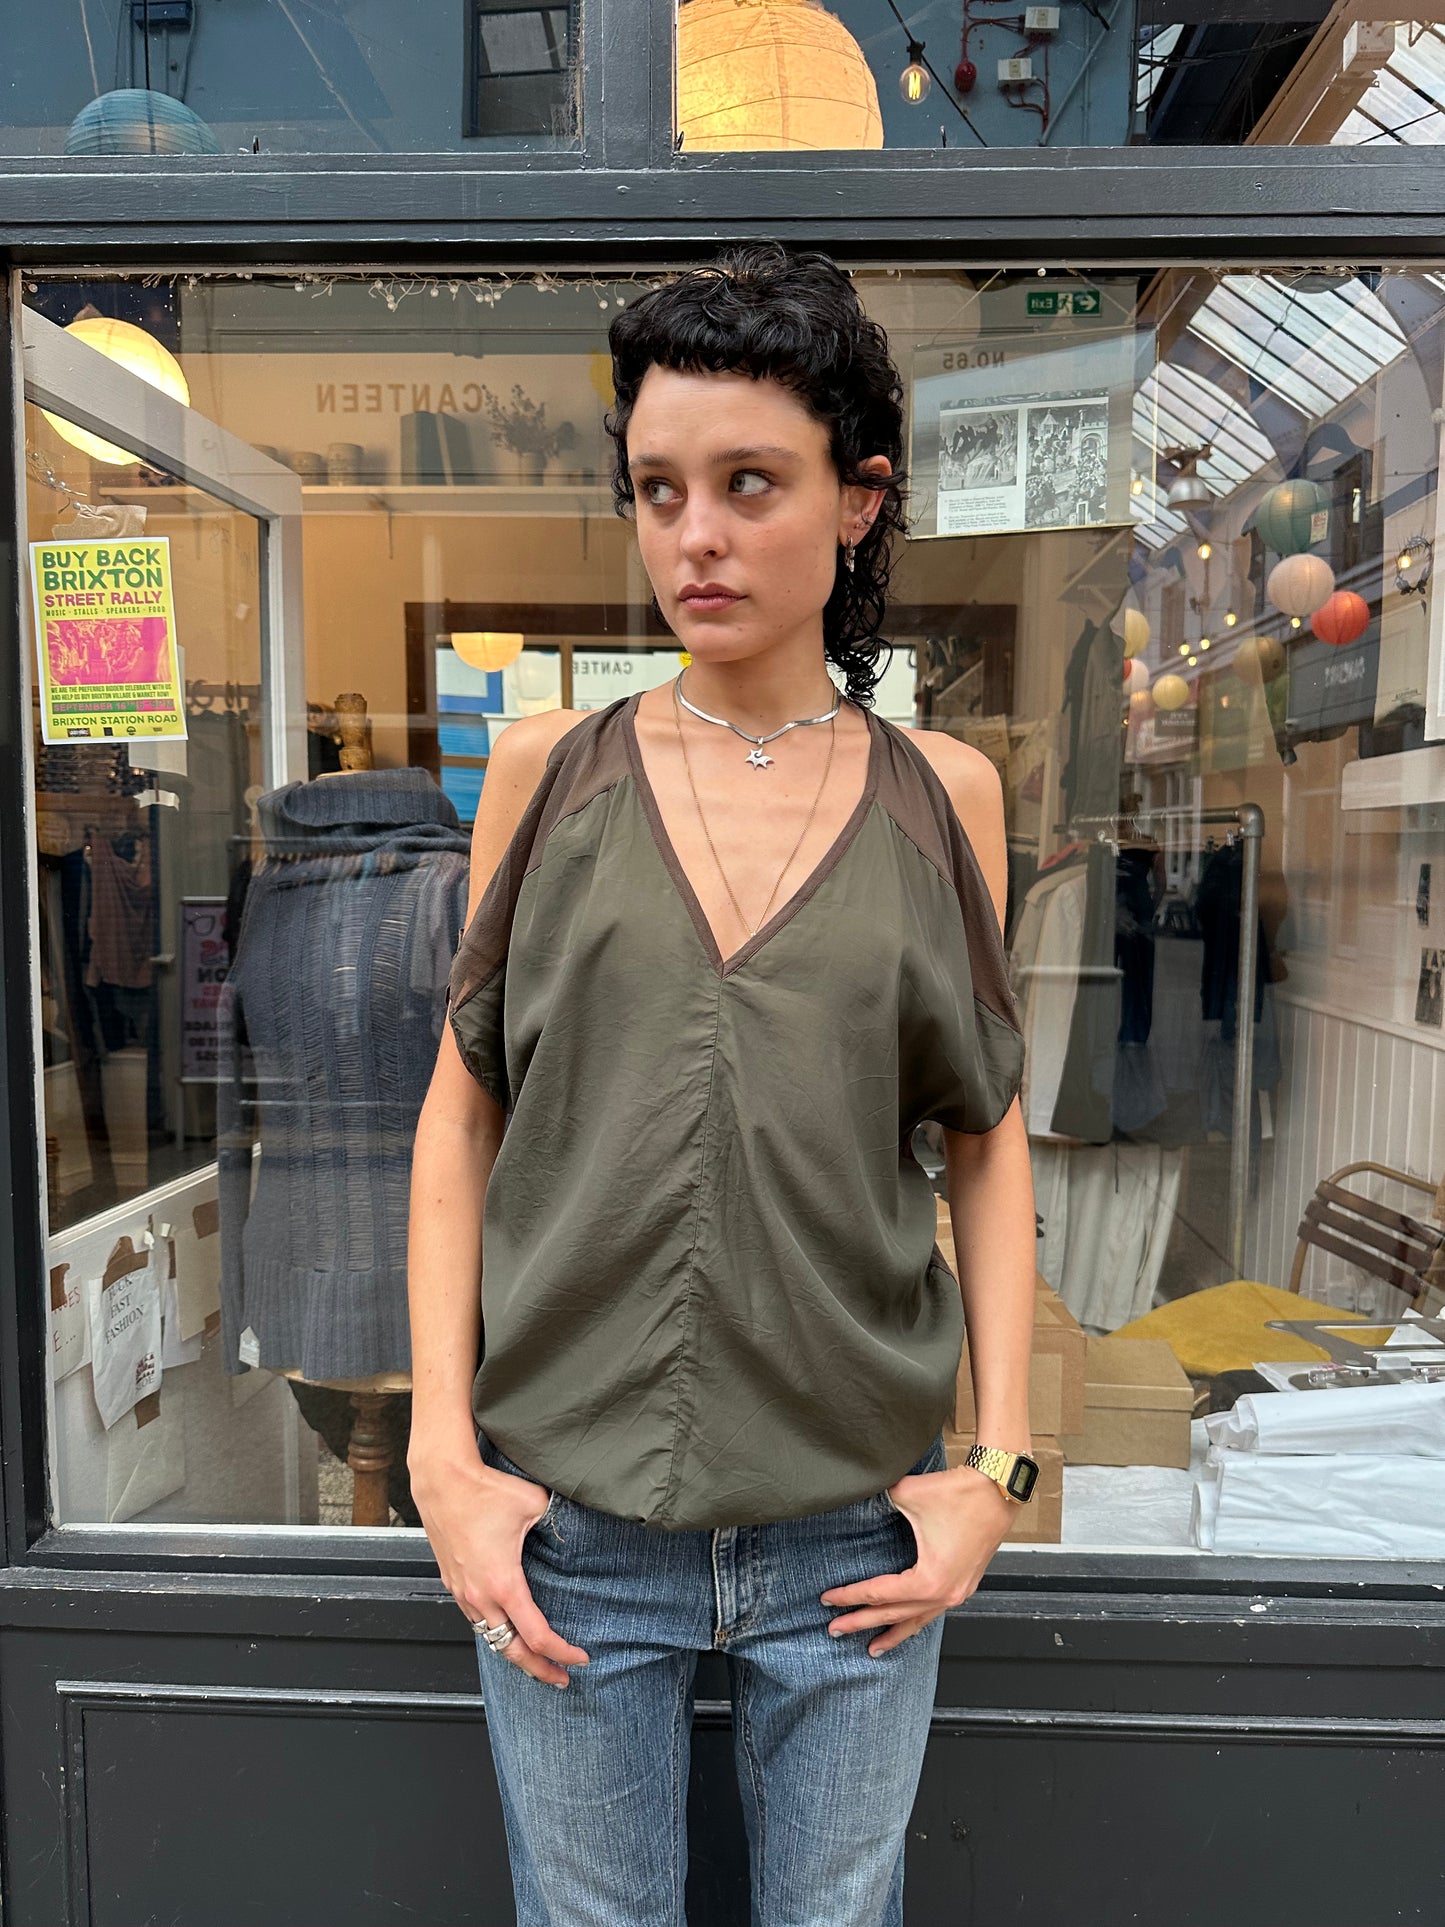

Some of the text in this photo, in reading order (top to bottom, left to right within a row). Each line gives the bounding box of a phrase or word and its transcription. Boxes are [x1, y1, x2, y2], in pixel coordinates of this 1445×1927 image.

[42, 548, 161, 569] BUY BACK
[44, 567, 163, 591] BRIXTON
[44, 591, 162, 608] STREET RALLY
[45, 605, 166, 617] MUSIC STALLS SPEAKERS FOOD
[91, 692, 111, 700] BRIXTON
[53, 702, 112, 712] SEPTEMBER
[52, 714, 178, 727] BRIXTON STATION ROAD
[110, 1292, 131, 1319] FAST
[105, 1304, 145, 1345] FASHION
